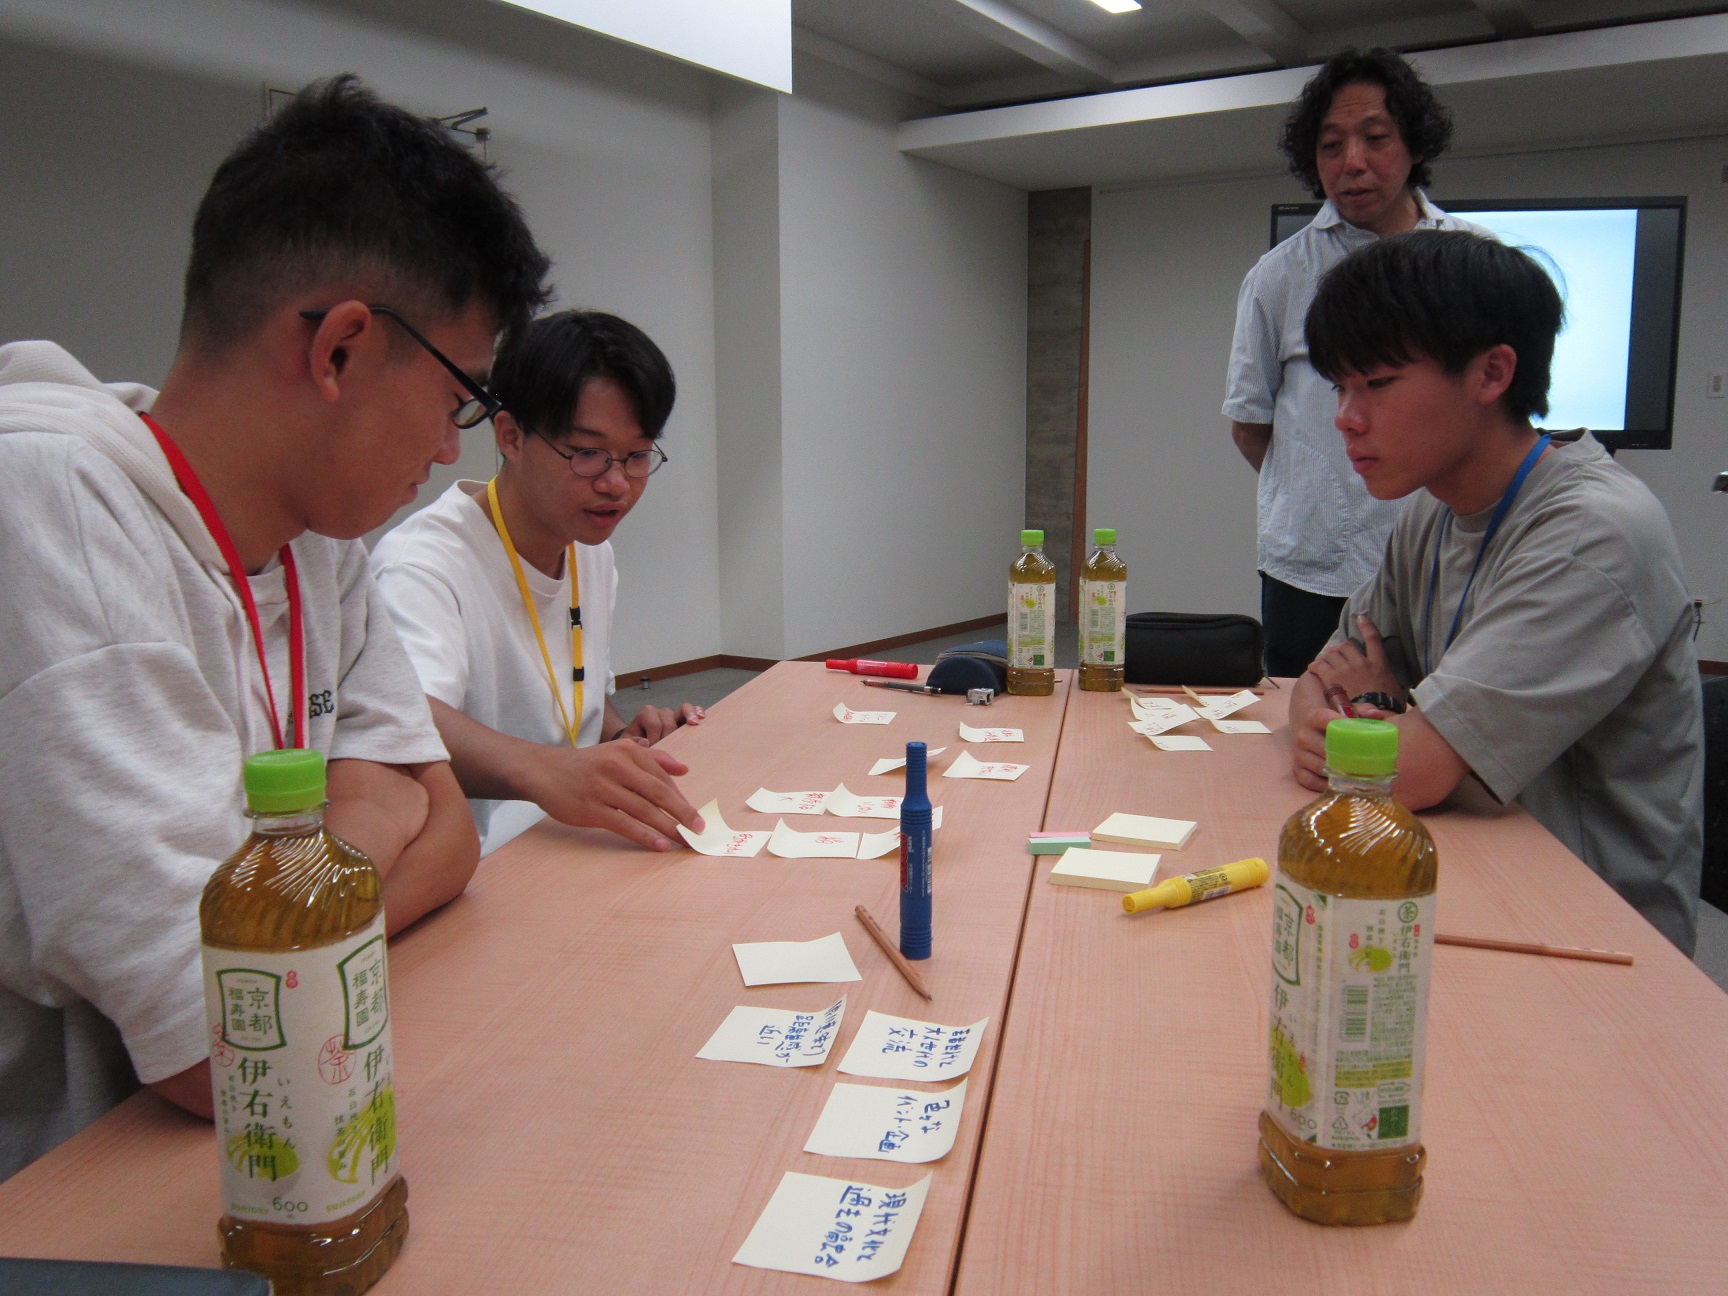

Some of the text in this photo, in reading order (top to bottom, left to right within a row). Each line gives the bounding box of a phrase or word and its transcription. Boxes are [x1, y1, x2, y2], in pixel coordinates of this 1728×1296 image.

[246, 986, 273, 1035] 京都
[756, 1023, 783, 1045] 近い
[881, 1026, 919, 1054] 交流
[912, 1026, 948, 1068] 大人世代の
[236, 1055, 278, 1183] 伊右衛門
[277, 1076, 296, 1150] いえもん
[918, 1099, 950, 1135] 色々な
[1290, 1108, 1317, 1130] 600
[272, 1196, 309, 1213] 600
[813, 1185, 873, 1268] 過去の融合
[855, 1192, 907, 1263] 現代文化と
